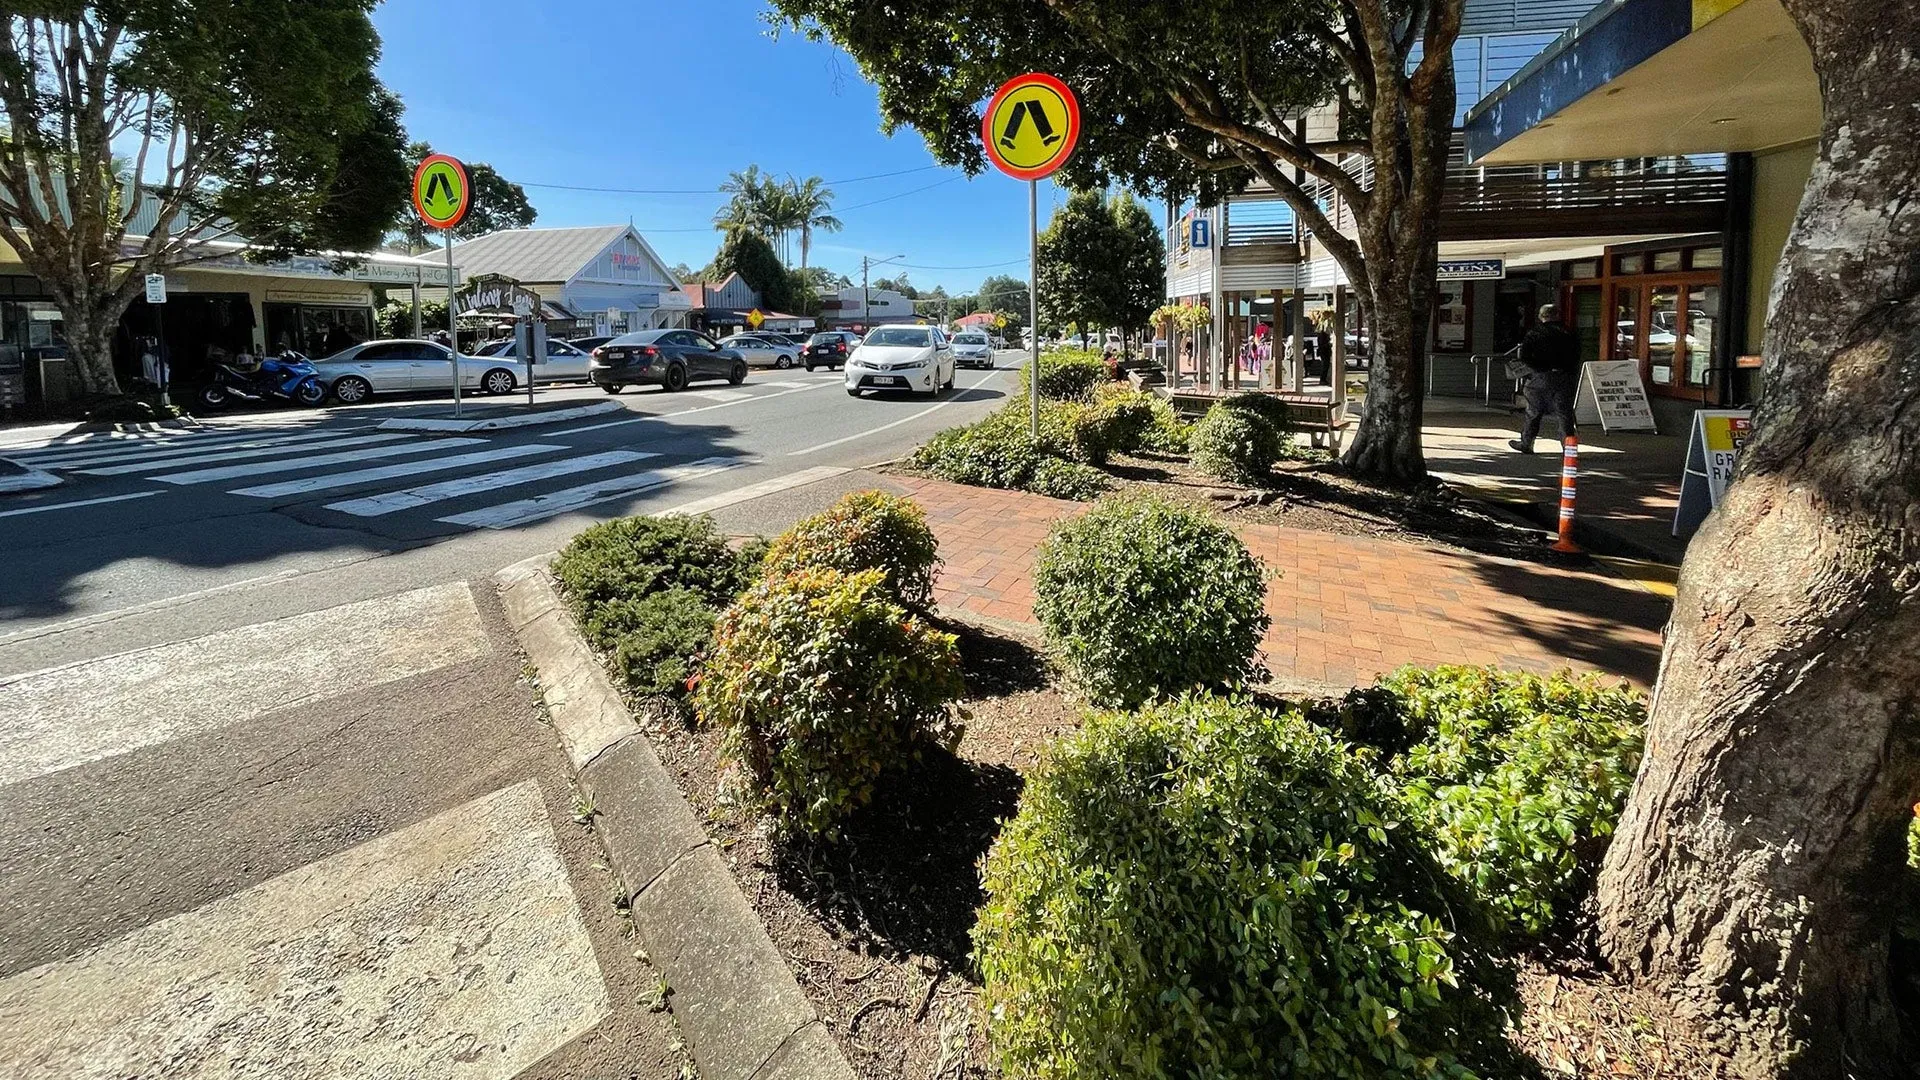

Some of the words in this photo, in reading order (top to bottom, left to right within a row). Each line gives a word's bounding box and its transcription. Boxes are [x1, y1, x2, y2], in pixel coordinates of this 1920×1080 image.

[372, 265, 400, 279] Maleny
[1437, 264, 1498, 272] ALENY
[147, 276, 163, 284] 2P
